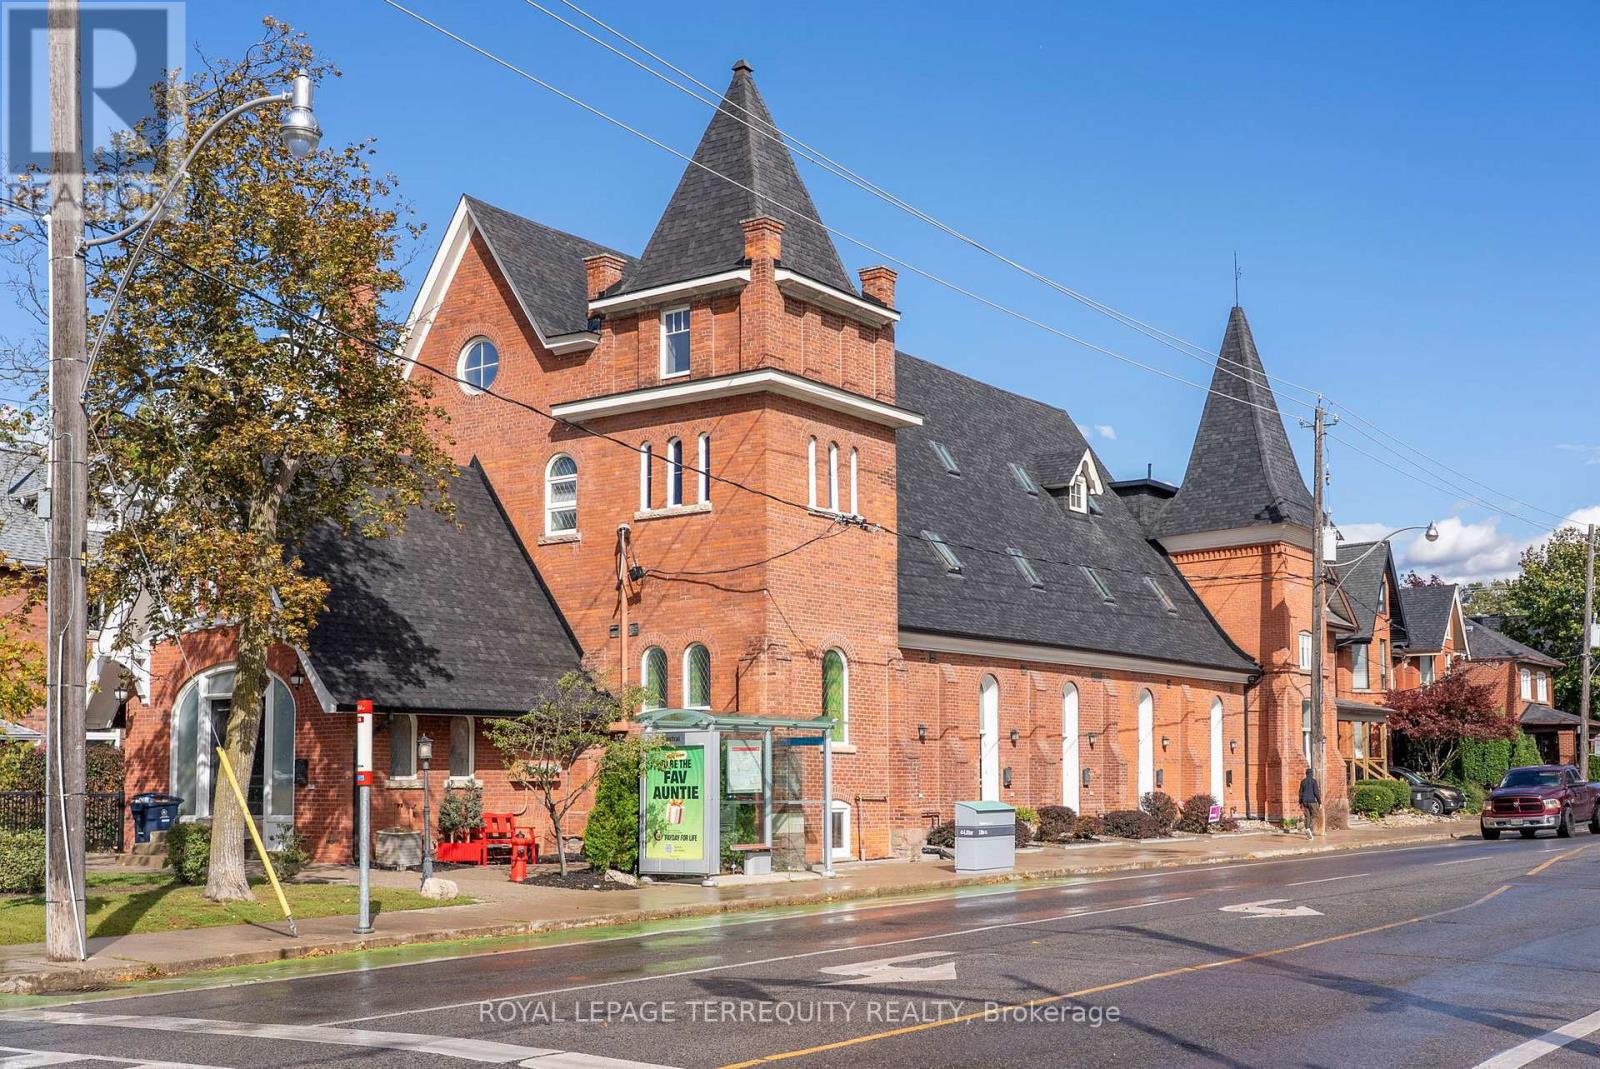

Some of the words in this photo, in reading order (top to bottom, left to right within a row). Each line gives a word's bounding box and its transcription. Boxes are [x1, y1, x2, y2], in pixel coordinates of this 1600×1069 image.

[680, 759, 692, 768] THE
[663, 770, 687, 784] FAV
[653, 785, 699, 800] AUNTIE
